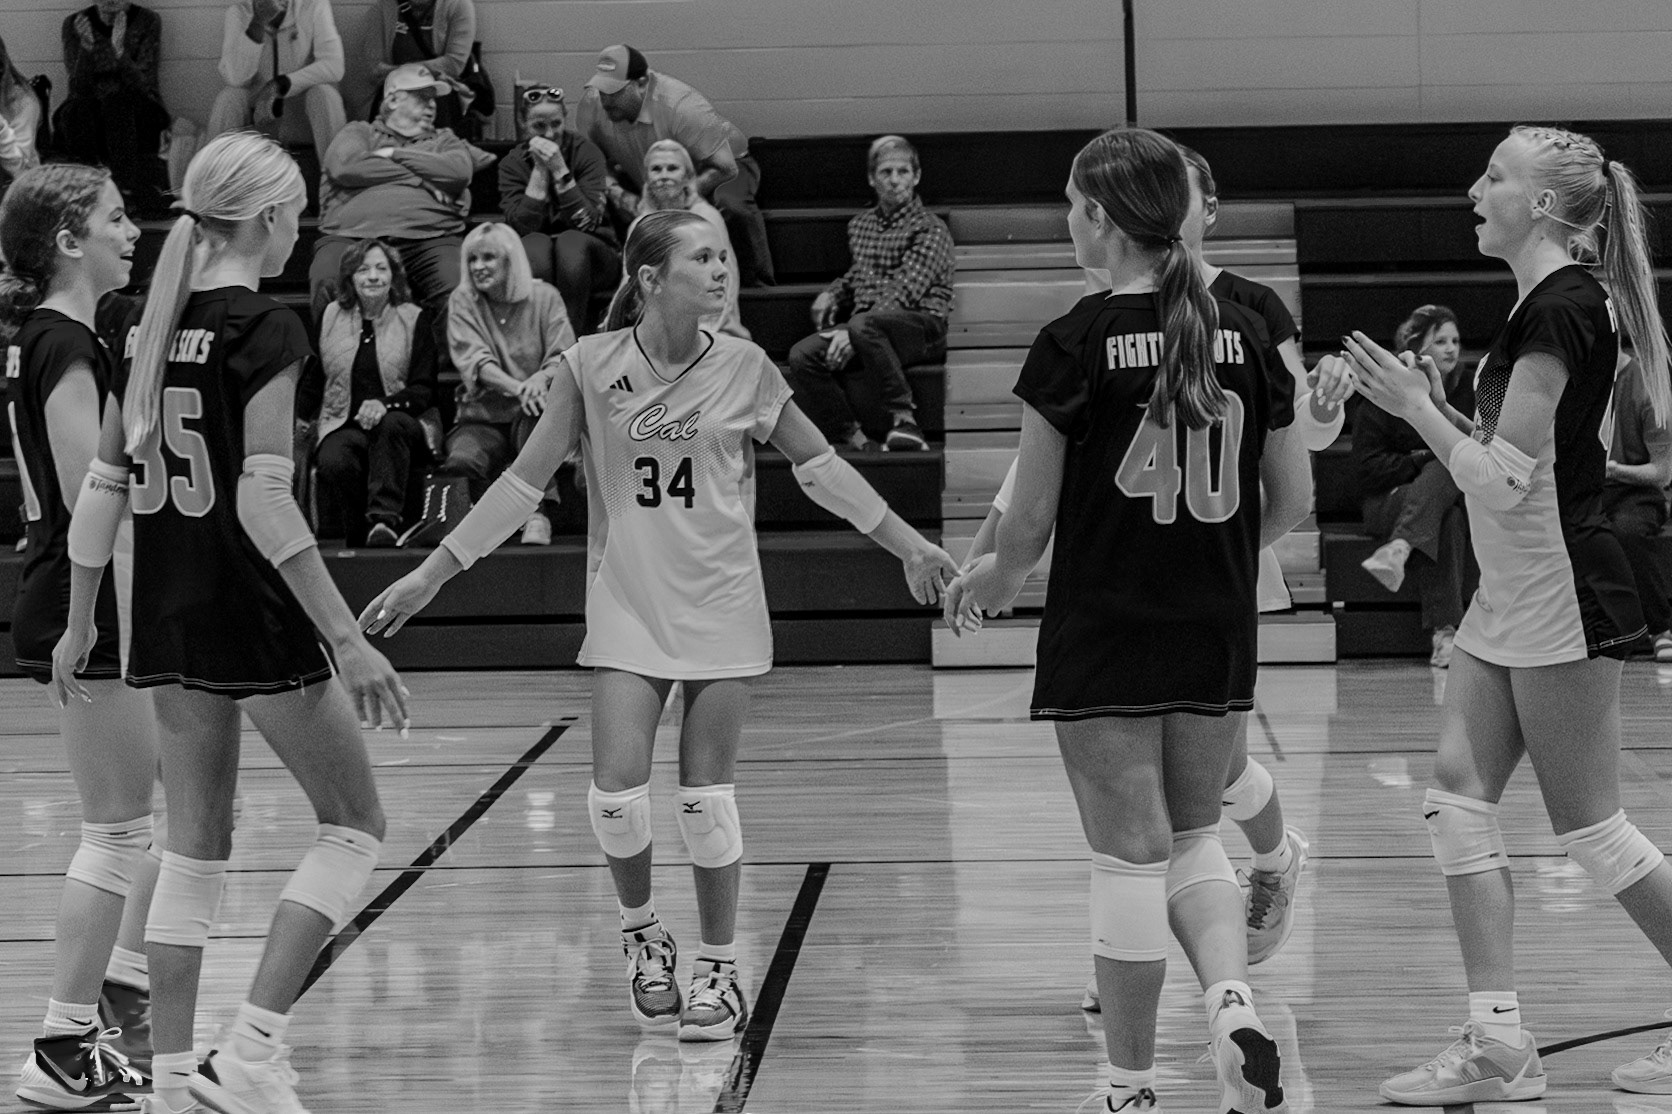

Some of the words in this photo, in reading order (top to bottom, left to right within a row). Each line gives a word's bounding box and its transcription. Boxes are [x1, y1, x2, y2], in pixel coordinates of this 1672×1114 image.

[1213, 329, 1245, 364] OTS
[628, 403, 701, 442] Cal
[1114, 389, 1245, 525] 40
[634, 456, 695, 508] 34
